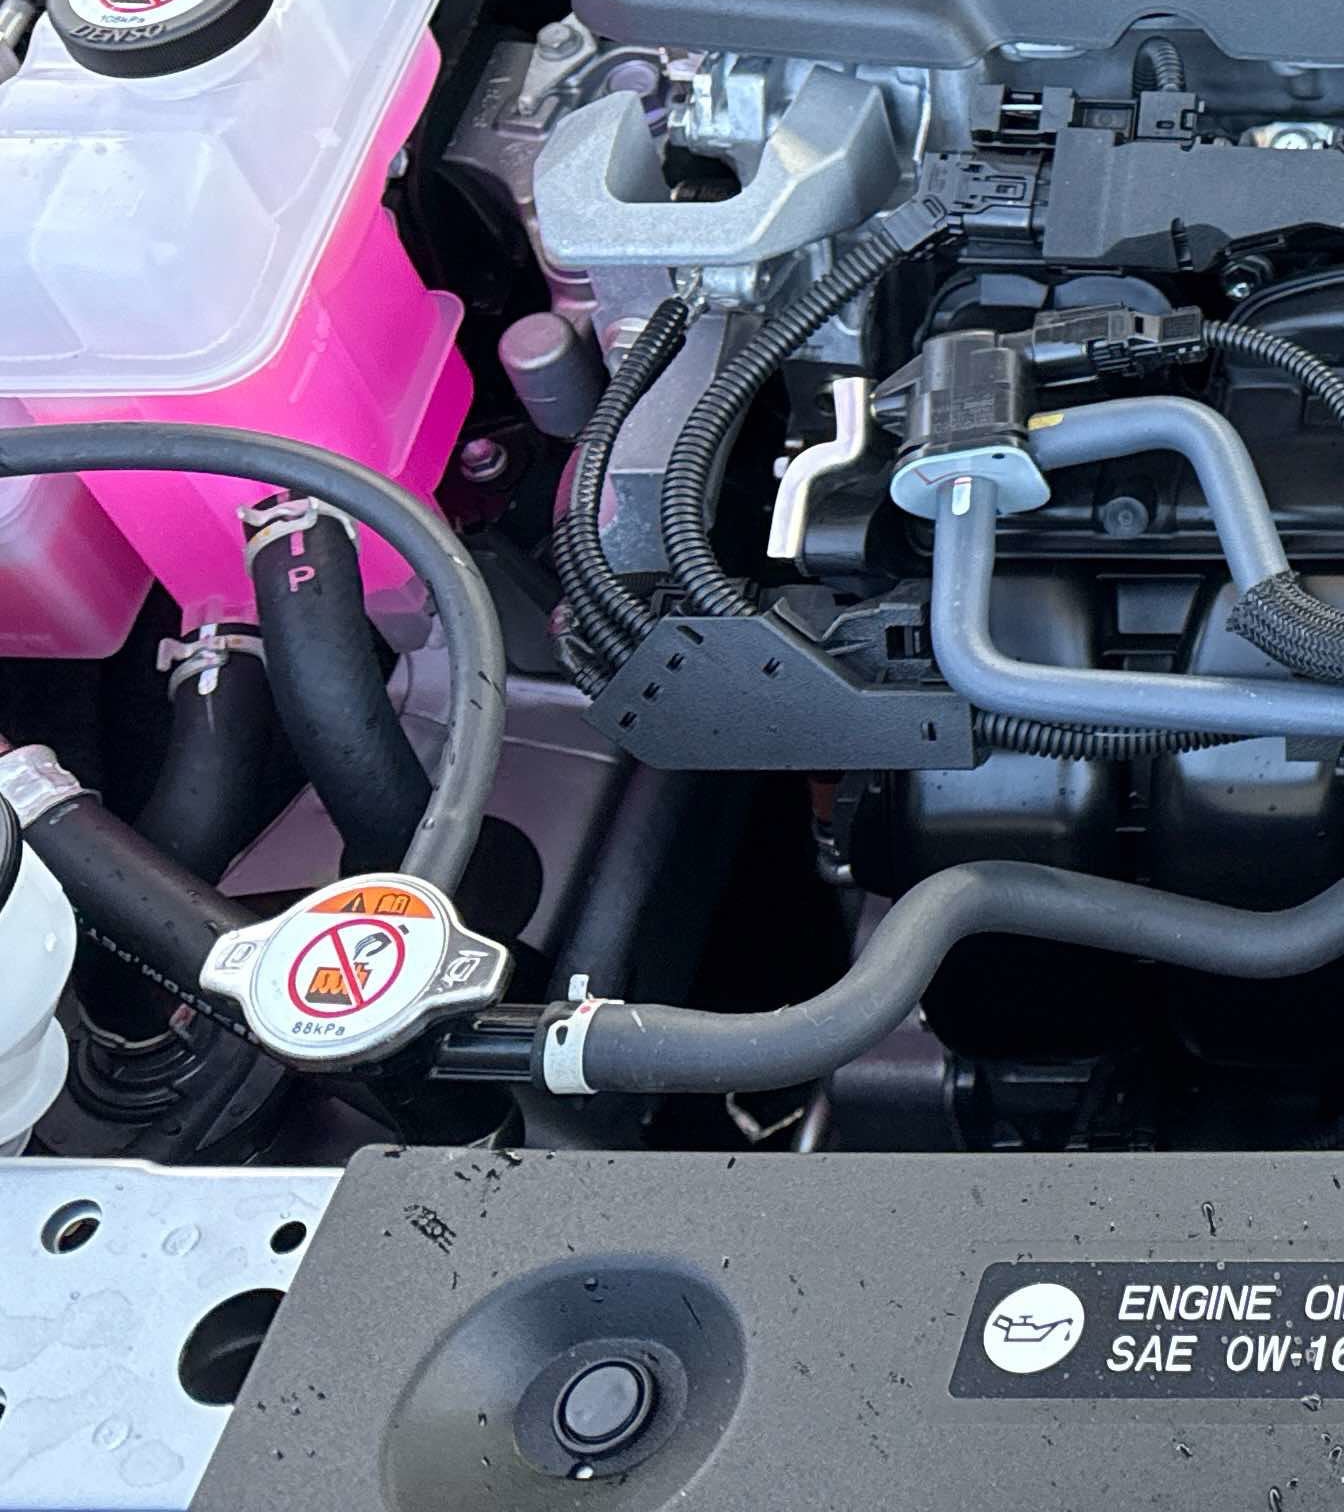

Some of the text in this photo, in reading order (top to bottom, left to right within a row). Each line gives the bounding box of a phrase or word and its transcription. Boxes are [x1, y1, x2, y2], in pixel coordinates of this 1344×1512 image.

[69, 23, 167, 44] DENSO
[288, 565, 316, 593] P
[291, 1021, 346, 1036] 88kPa
[1117, 1284, 1277, 1321] ENGINE
[1105, 1334, 1199, 1373] SAE
